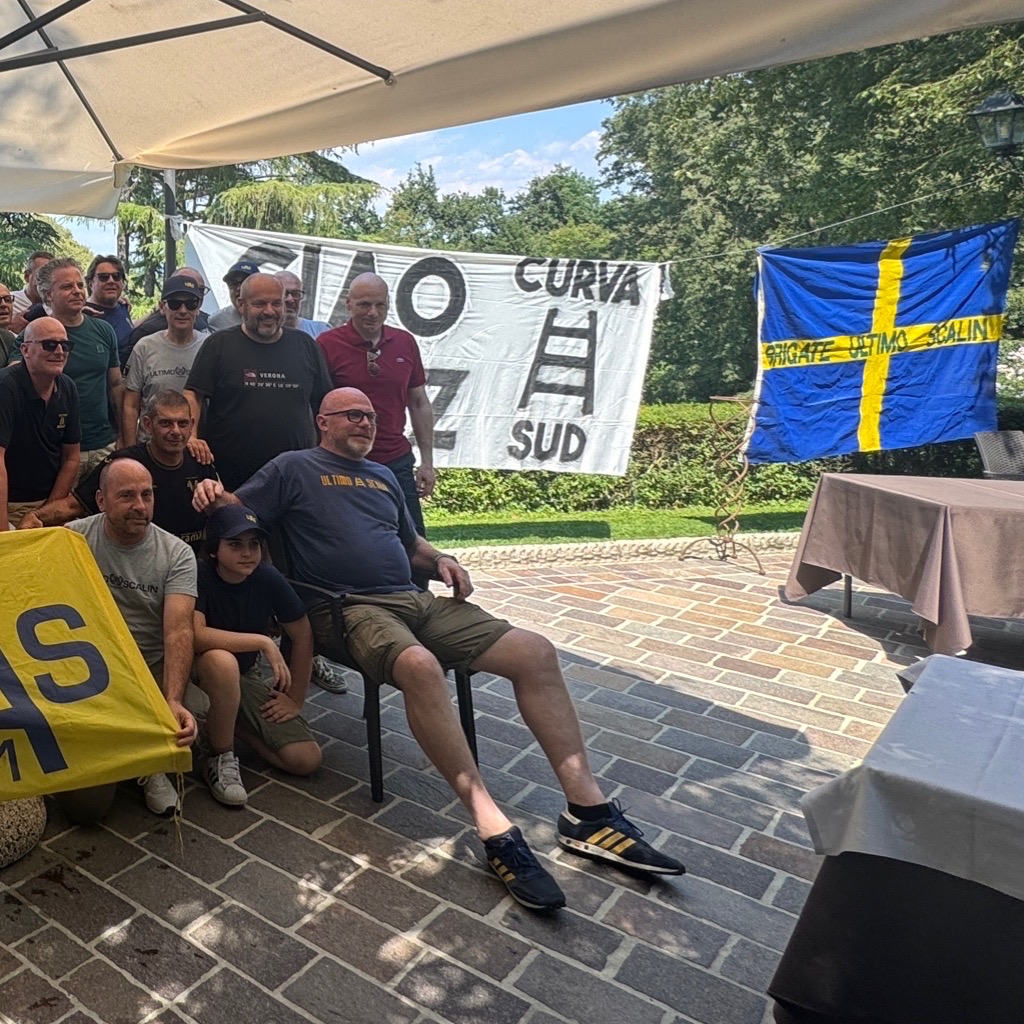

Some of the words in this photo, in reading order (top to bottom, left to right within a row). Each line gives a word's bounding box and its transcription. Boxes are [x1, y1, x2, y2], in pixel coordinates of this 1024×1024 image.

[515, 257, 640, 306] CURVA
[765, 339, 836, 367] BRIGATE
[848, 330, 909, 359] ULTIMO
[925, 318, 989, 347] SCALIN
[506, 419, 587, 463] SUD
[122, 580, 159, 594] SCALIN
